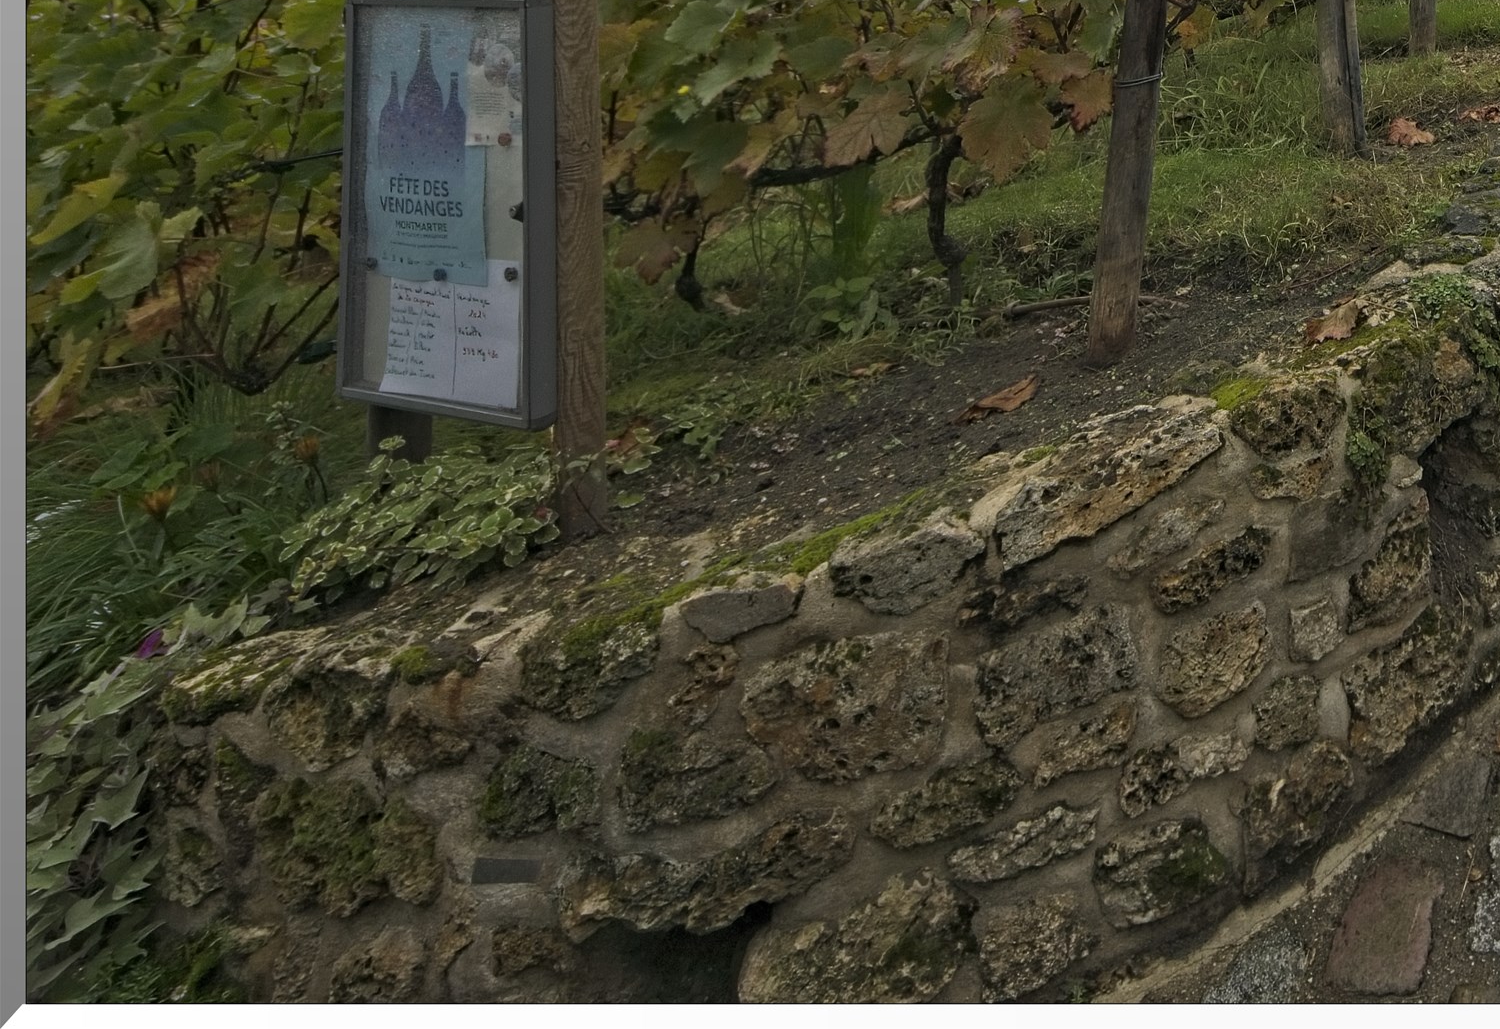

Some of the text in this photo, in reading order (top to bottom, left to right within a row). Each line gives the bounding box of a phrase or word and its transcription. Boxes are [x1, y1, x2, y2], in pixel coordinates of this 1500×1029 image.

[389, 173, 449, 197] FÊTE DES
[379, 195, 464, 218] VENDANGES
[395, 219, 448, 232] MONTMARTRE
